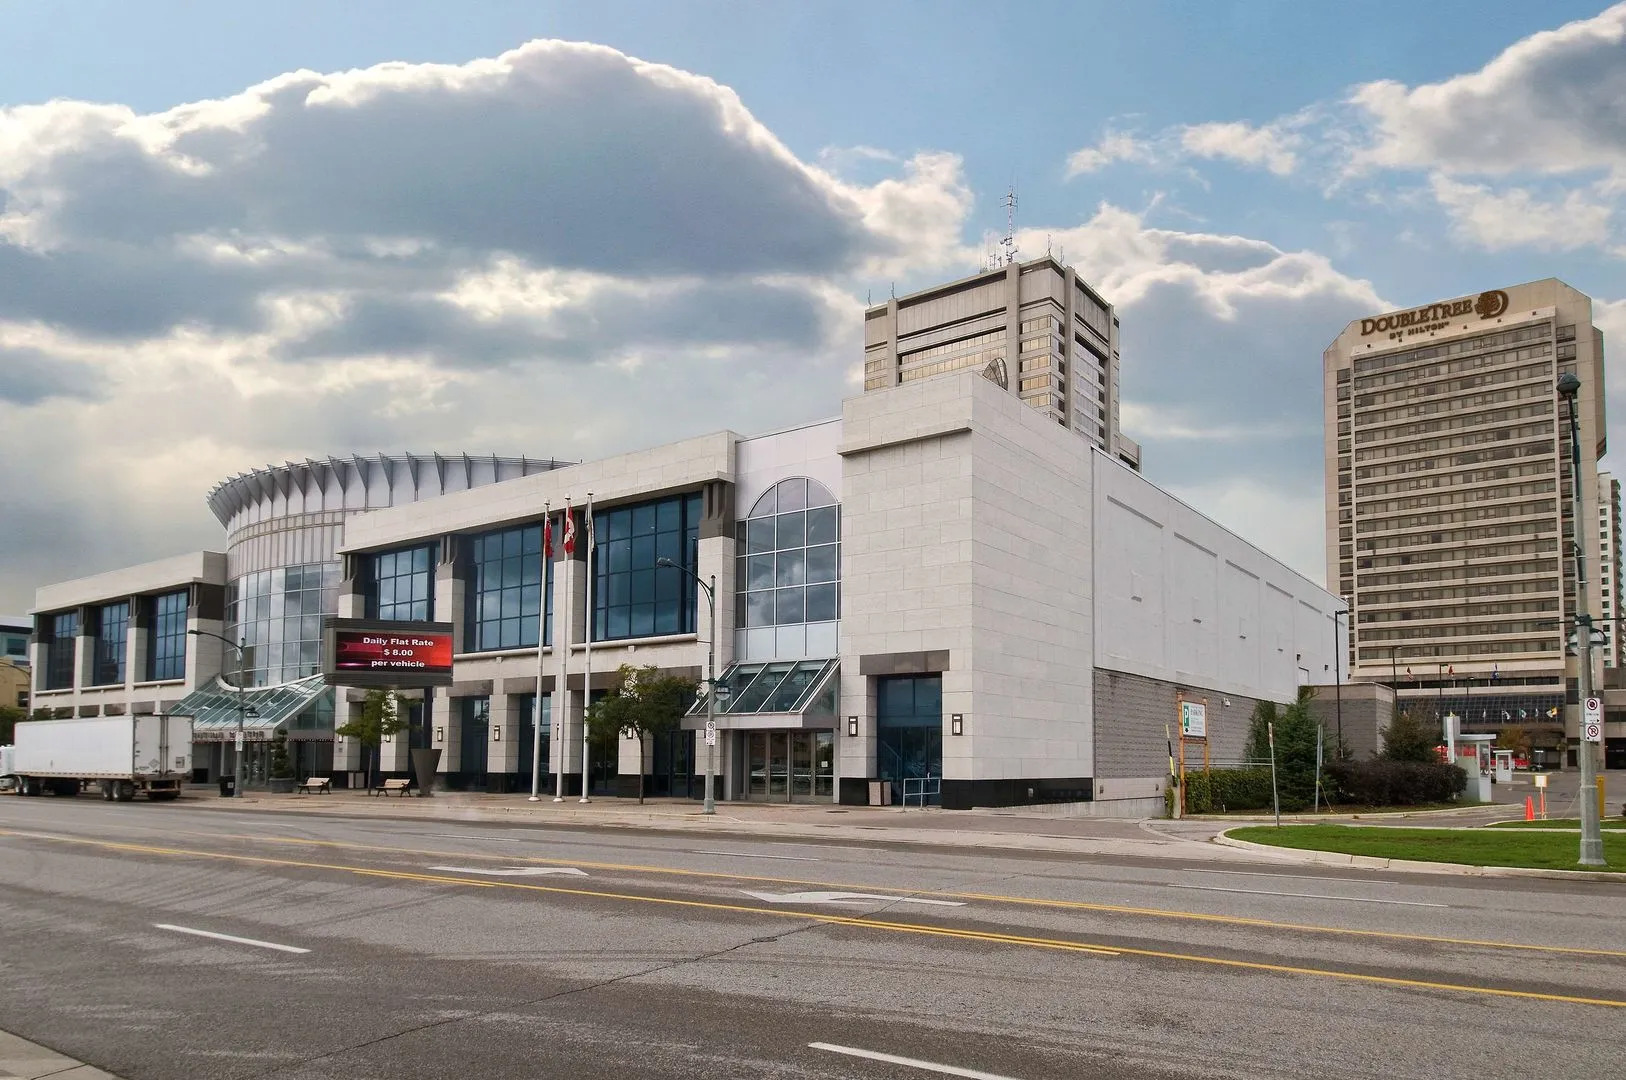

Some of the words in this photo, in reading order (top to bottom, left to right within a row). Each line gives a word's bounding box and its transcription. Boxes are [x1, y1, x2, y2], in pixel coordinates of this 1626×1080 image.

[1389, 331, 1403, 340] BY
[1408, 323, 1446, 335] HILTON
[363, 637, 388, 646] Daily
[390, 638, 409, 646] Flat
[412, 639, 434, 647] Rate
[392, 649, 414, 657] 8.00
[371, 660, 387, 668] per
[390, 660, 425, 668] vehicle
